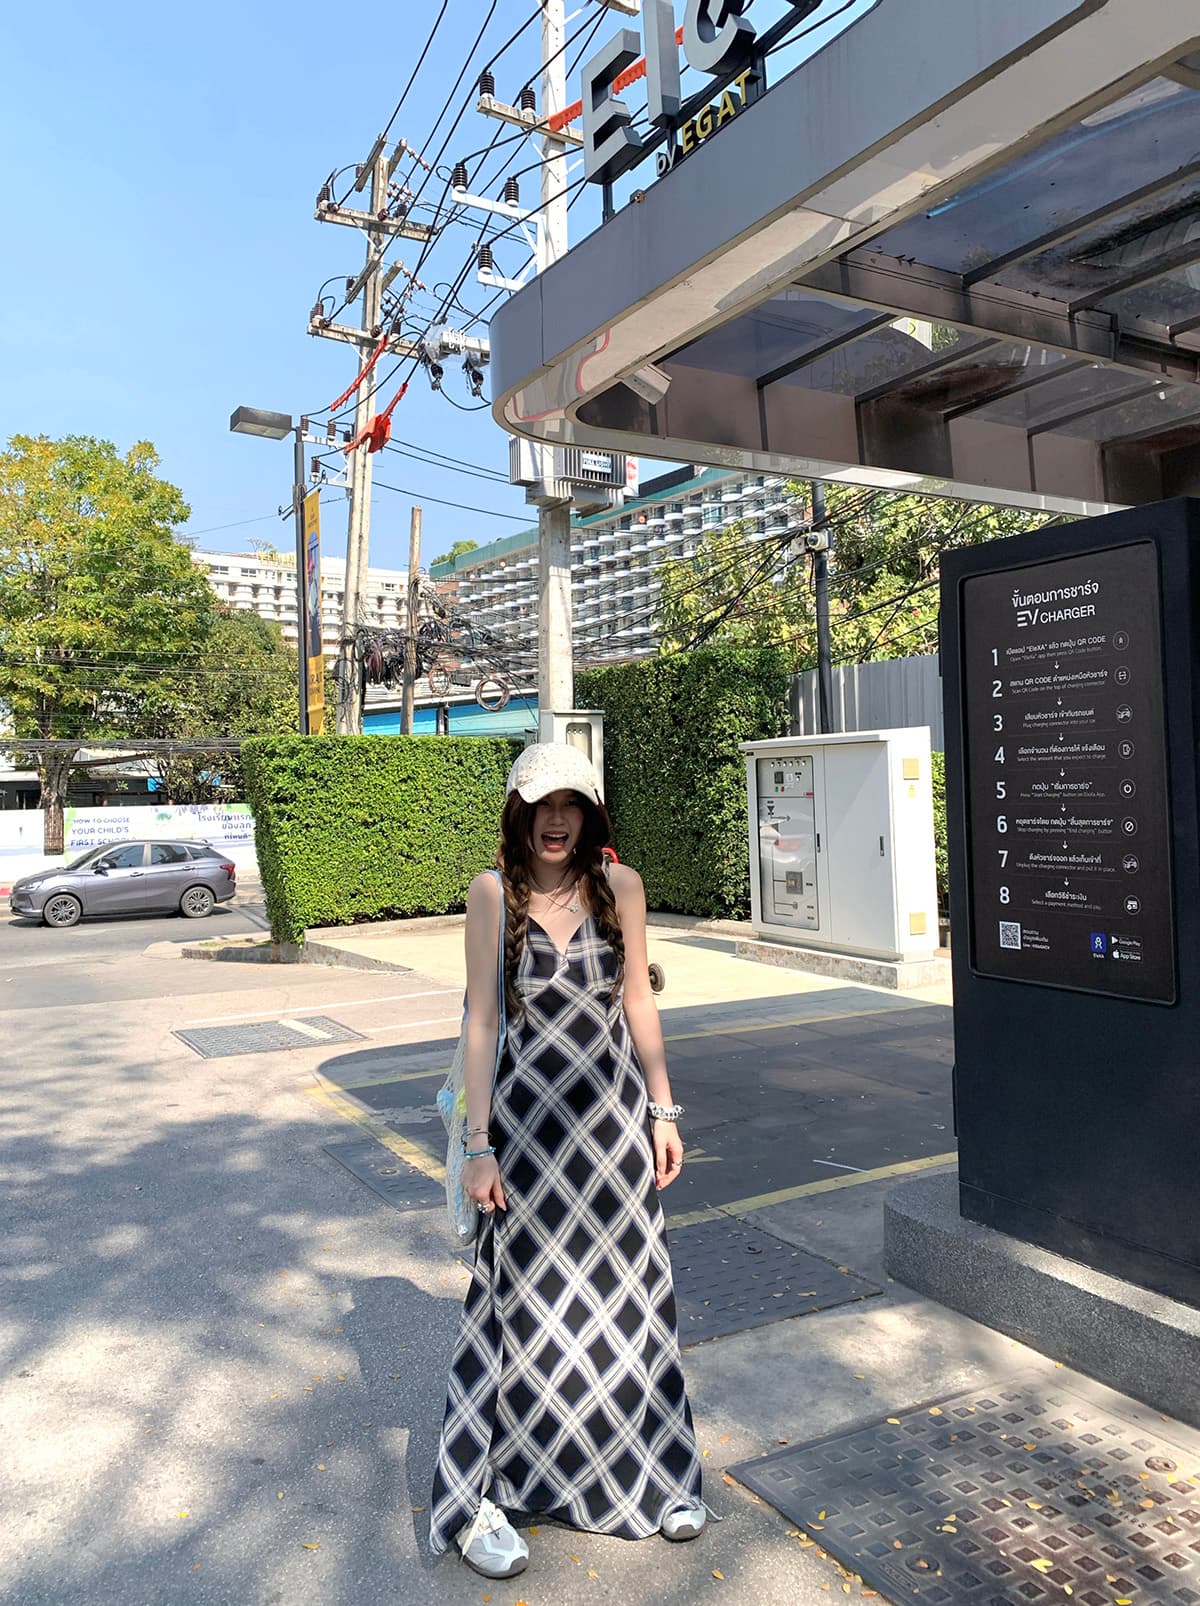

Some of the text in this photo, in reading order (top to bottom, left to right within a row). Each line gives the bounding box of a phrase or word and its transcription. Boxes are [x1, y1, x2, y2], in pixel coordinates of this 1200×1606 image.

[656, 67, 752, 177] by EGAT
[1011, 580, 1099, 608] ขั้นตอนการชาร์จ
[1017, 604, 1096, 627] EV CHARGER
[1088, 635, 1106, 644] CODE
[991, 648, 998, 666] 1
[992, 680, 1003, 697] 2
[1034, 675, 1052, 685] CODE
[993, 714, 1003, 731] 3
[994, 746, 1005, 764] 4
[996, 781, 1006, 799] 5
[97, 826, 129, 834] CHILD'S
[997, 815, 1008, 833] 6
[70, 839, 94, 847] FIRST
[998, 850, 1008, 868] 7
[1000, 886, 1010, 904] 8
